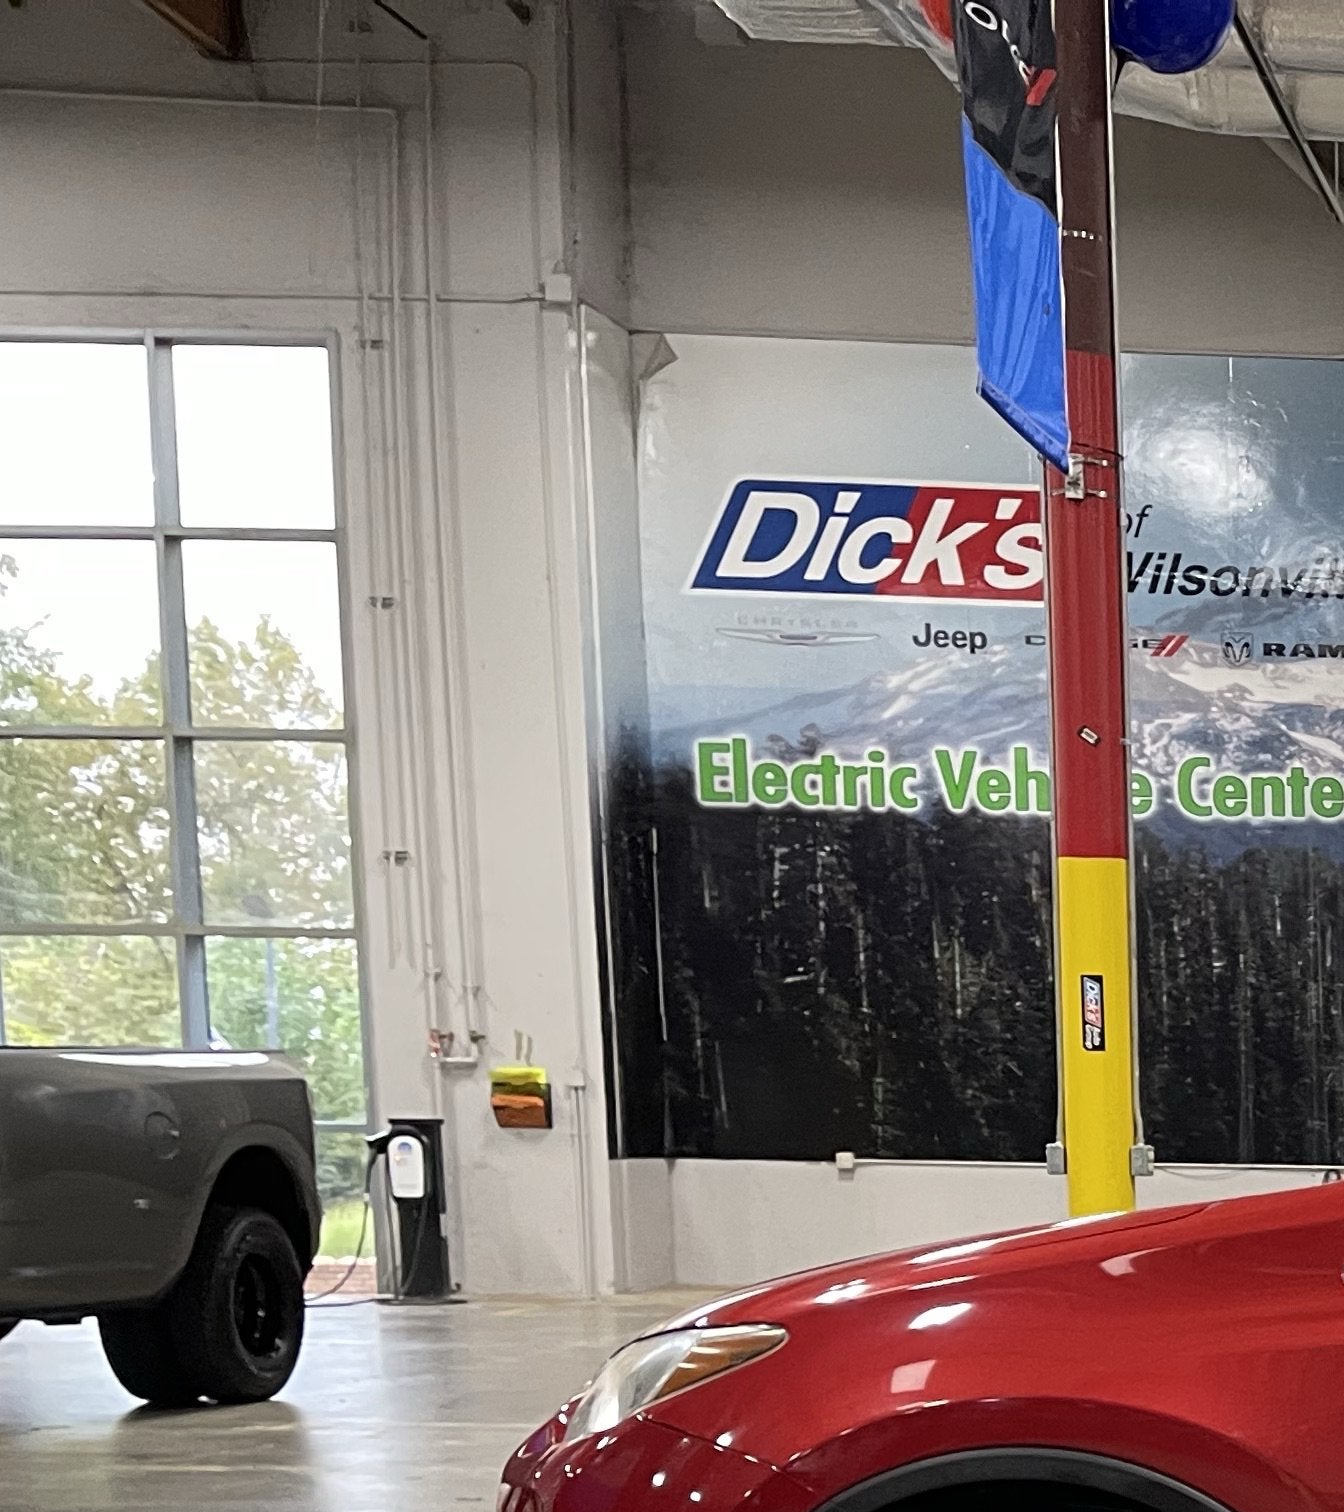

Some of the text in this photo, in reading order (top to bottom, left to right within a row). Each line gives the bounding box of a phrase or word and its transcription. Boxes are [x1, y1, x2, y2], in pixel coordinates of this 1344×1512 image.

[715, 490, 1045, 591] Dick's
[912, 622, 988, 653] Jeep
[697, 737, 918, 809] Electric
